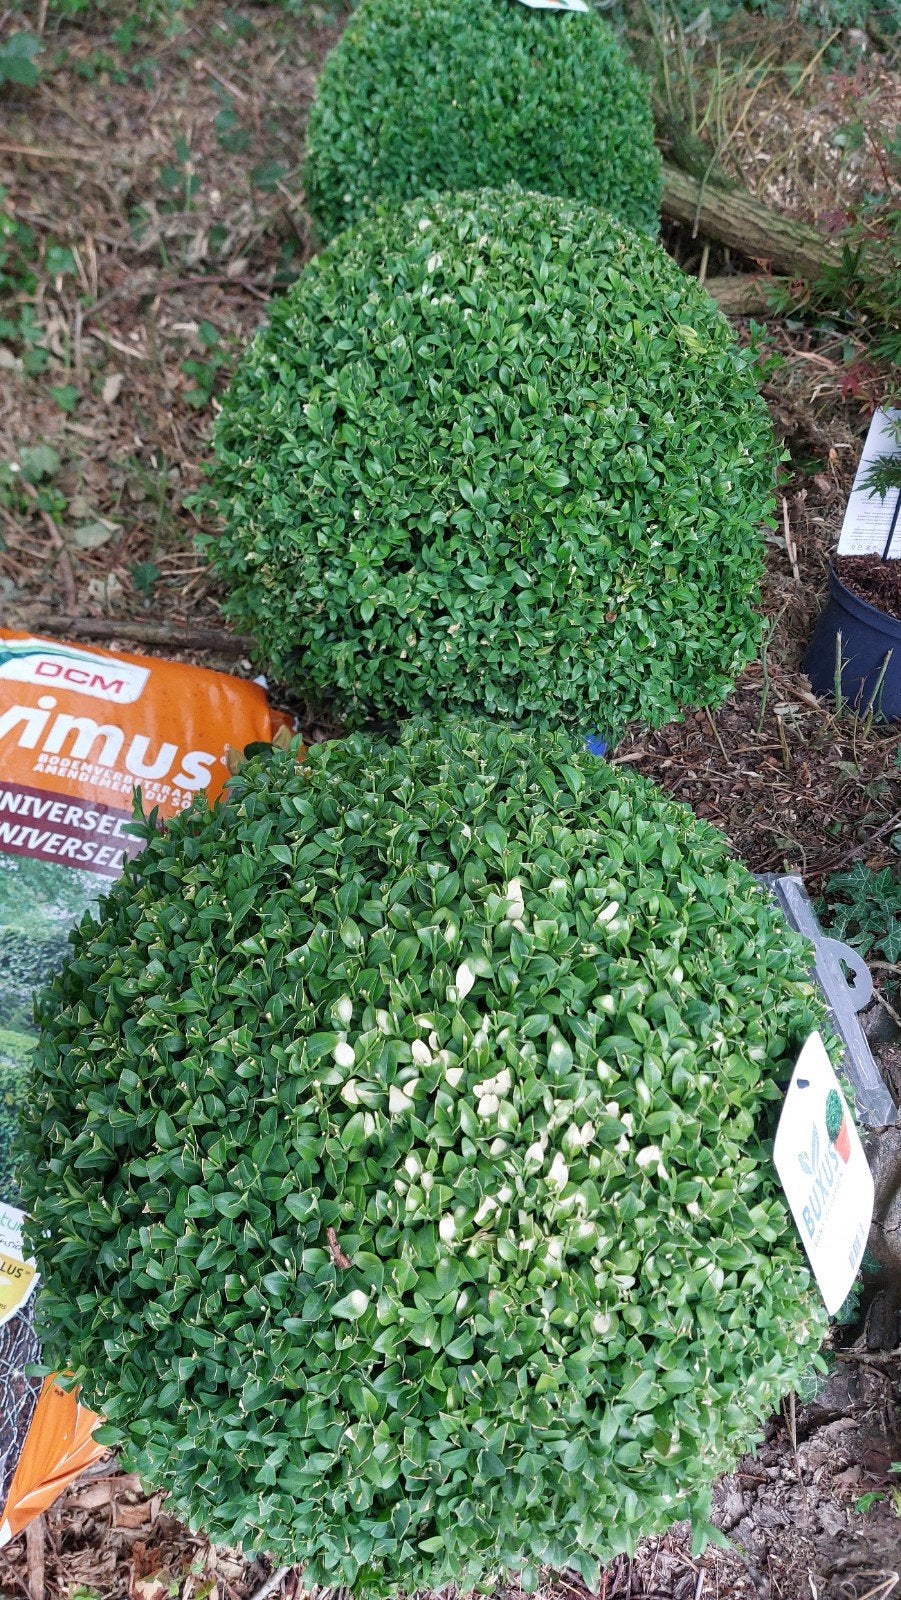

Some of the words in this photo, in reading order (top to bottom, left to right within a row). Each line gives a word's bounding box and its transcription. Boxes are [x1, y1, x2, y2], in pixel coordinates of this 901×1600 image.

[35, 661, 124, 694] DCM
[0, 790, 142, 843] NIVERSEE
[145, 790, 167, 804] DU
[0, 822, 125, 870] NIVERSEL
[802, 1143, 839, 1240] BUXUS
